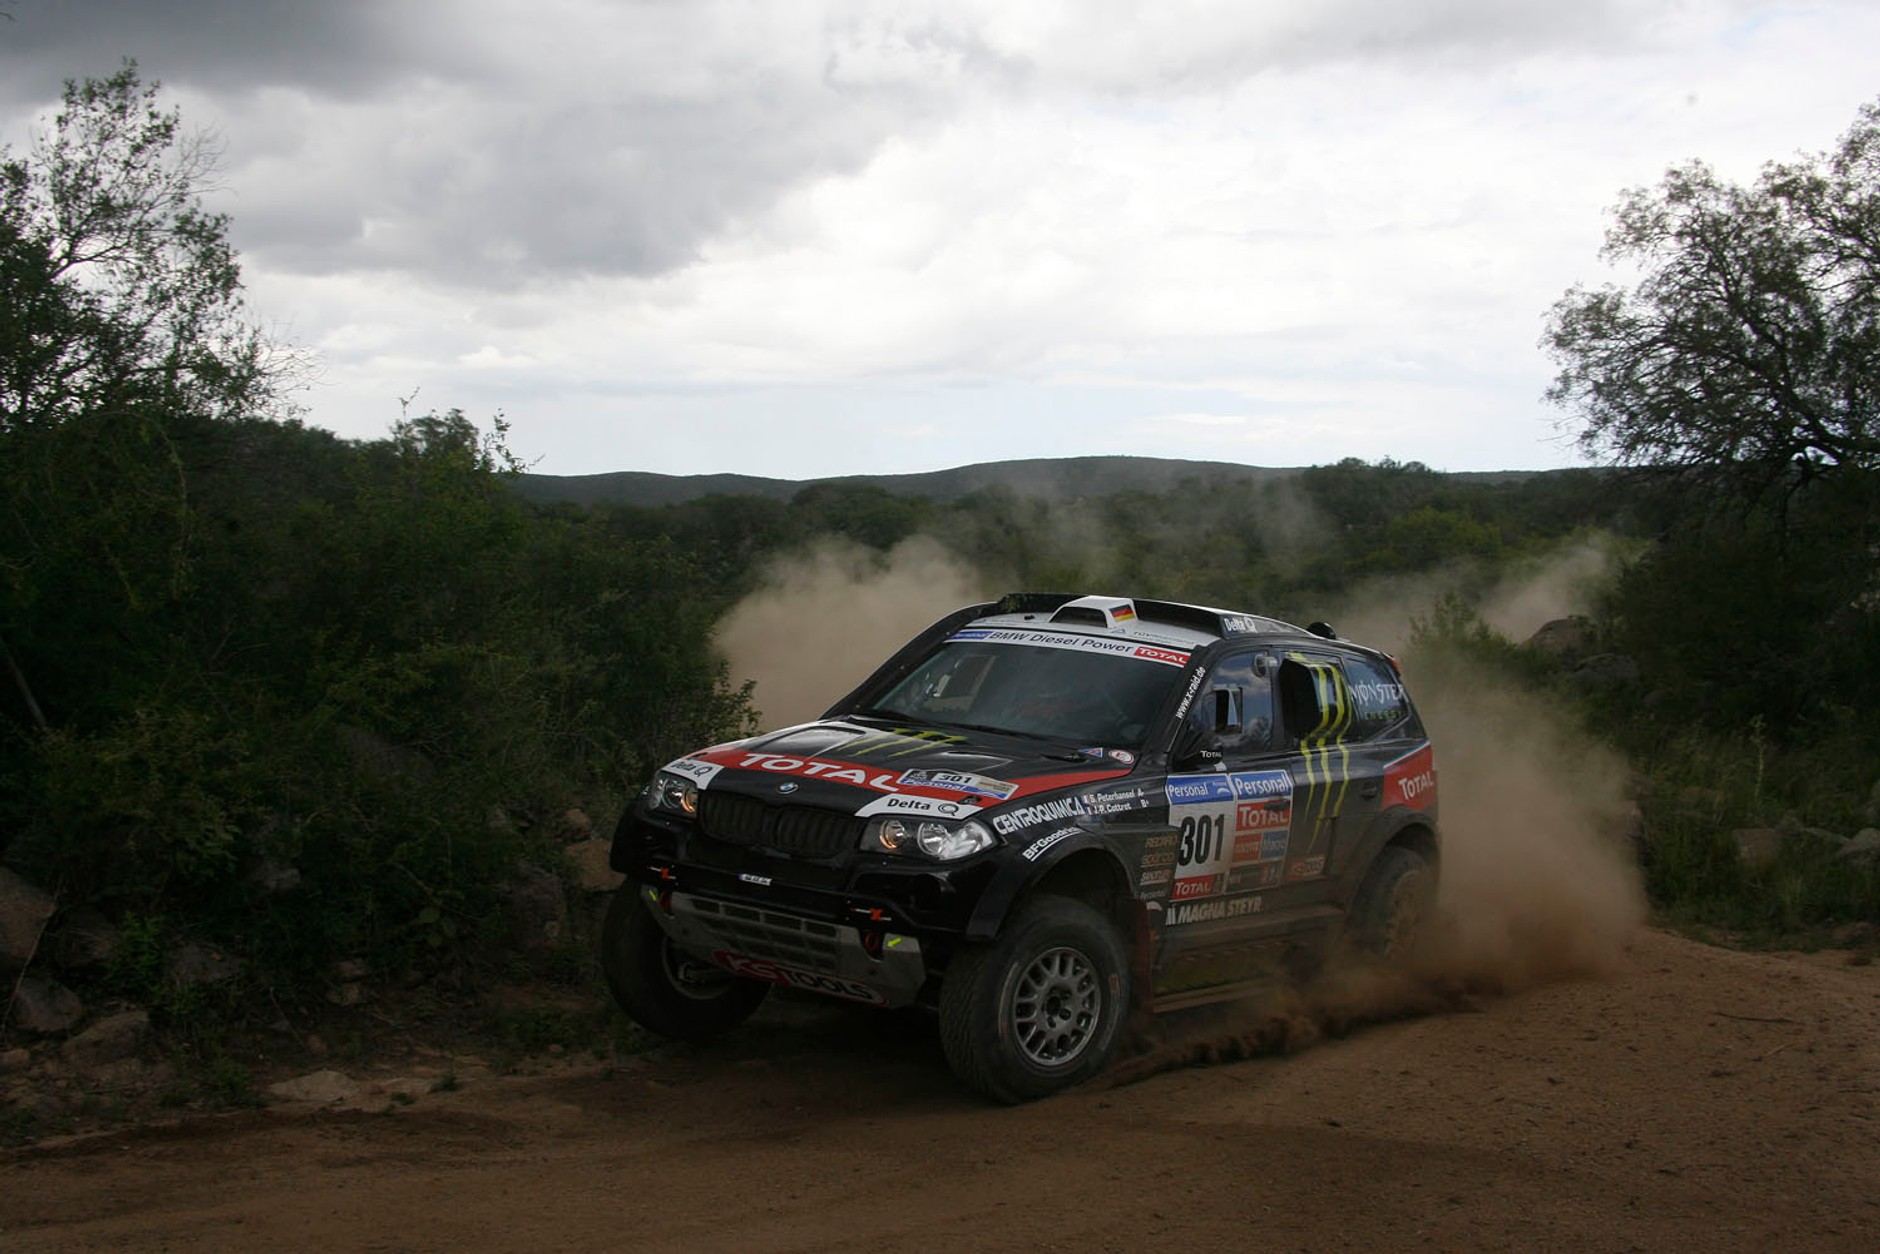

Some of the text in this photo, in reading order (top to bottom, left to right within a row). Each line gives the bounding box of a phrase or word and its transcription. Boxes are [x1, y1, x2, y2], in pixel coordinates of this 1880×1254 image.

[1223, 617, 1244, 632] Delta
[988, 631, 1033, 642] BMW
[1031, 633, 1079, 646] Diesel
[1082, 638, 1135, 653] Power
[1139, 647, 1188, 665] TOTAL
[1174, 665, 1207, 720] www.x-raid.de
[1200, 749, 1223, 759] TOTAL
[740, 753, 899, 792] TOTAL
[938, 774, 973, 784] 301
[1169, 784, 1209, 798] Personal
[1235, 774, 1290, 796] Personal
[1399, 775, 1434, 799] TOTAL
[887, 798, 931, 811] Delta
[992, 796, 1086, 836] CENTROQUIMICA
[1239, 806, 1289, 828] TOTAL
[1178, 814, 1225, 867] 301
[1175, 881, 1211, 896] TOTAL
[1178, 896, 1263, 924] MAGNA STEYR
